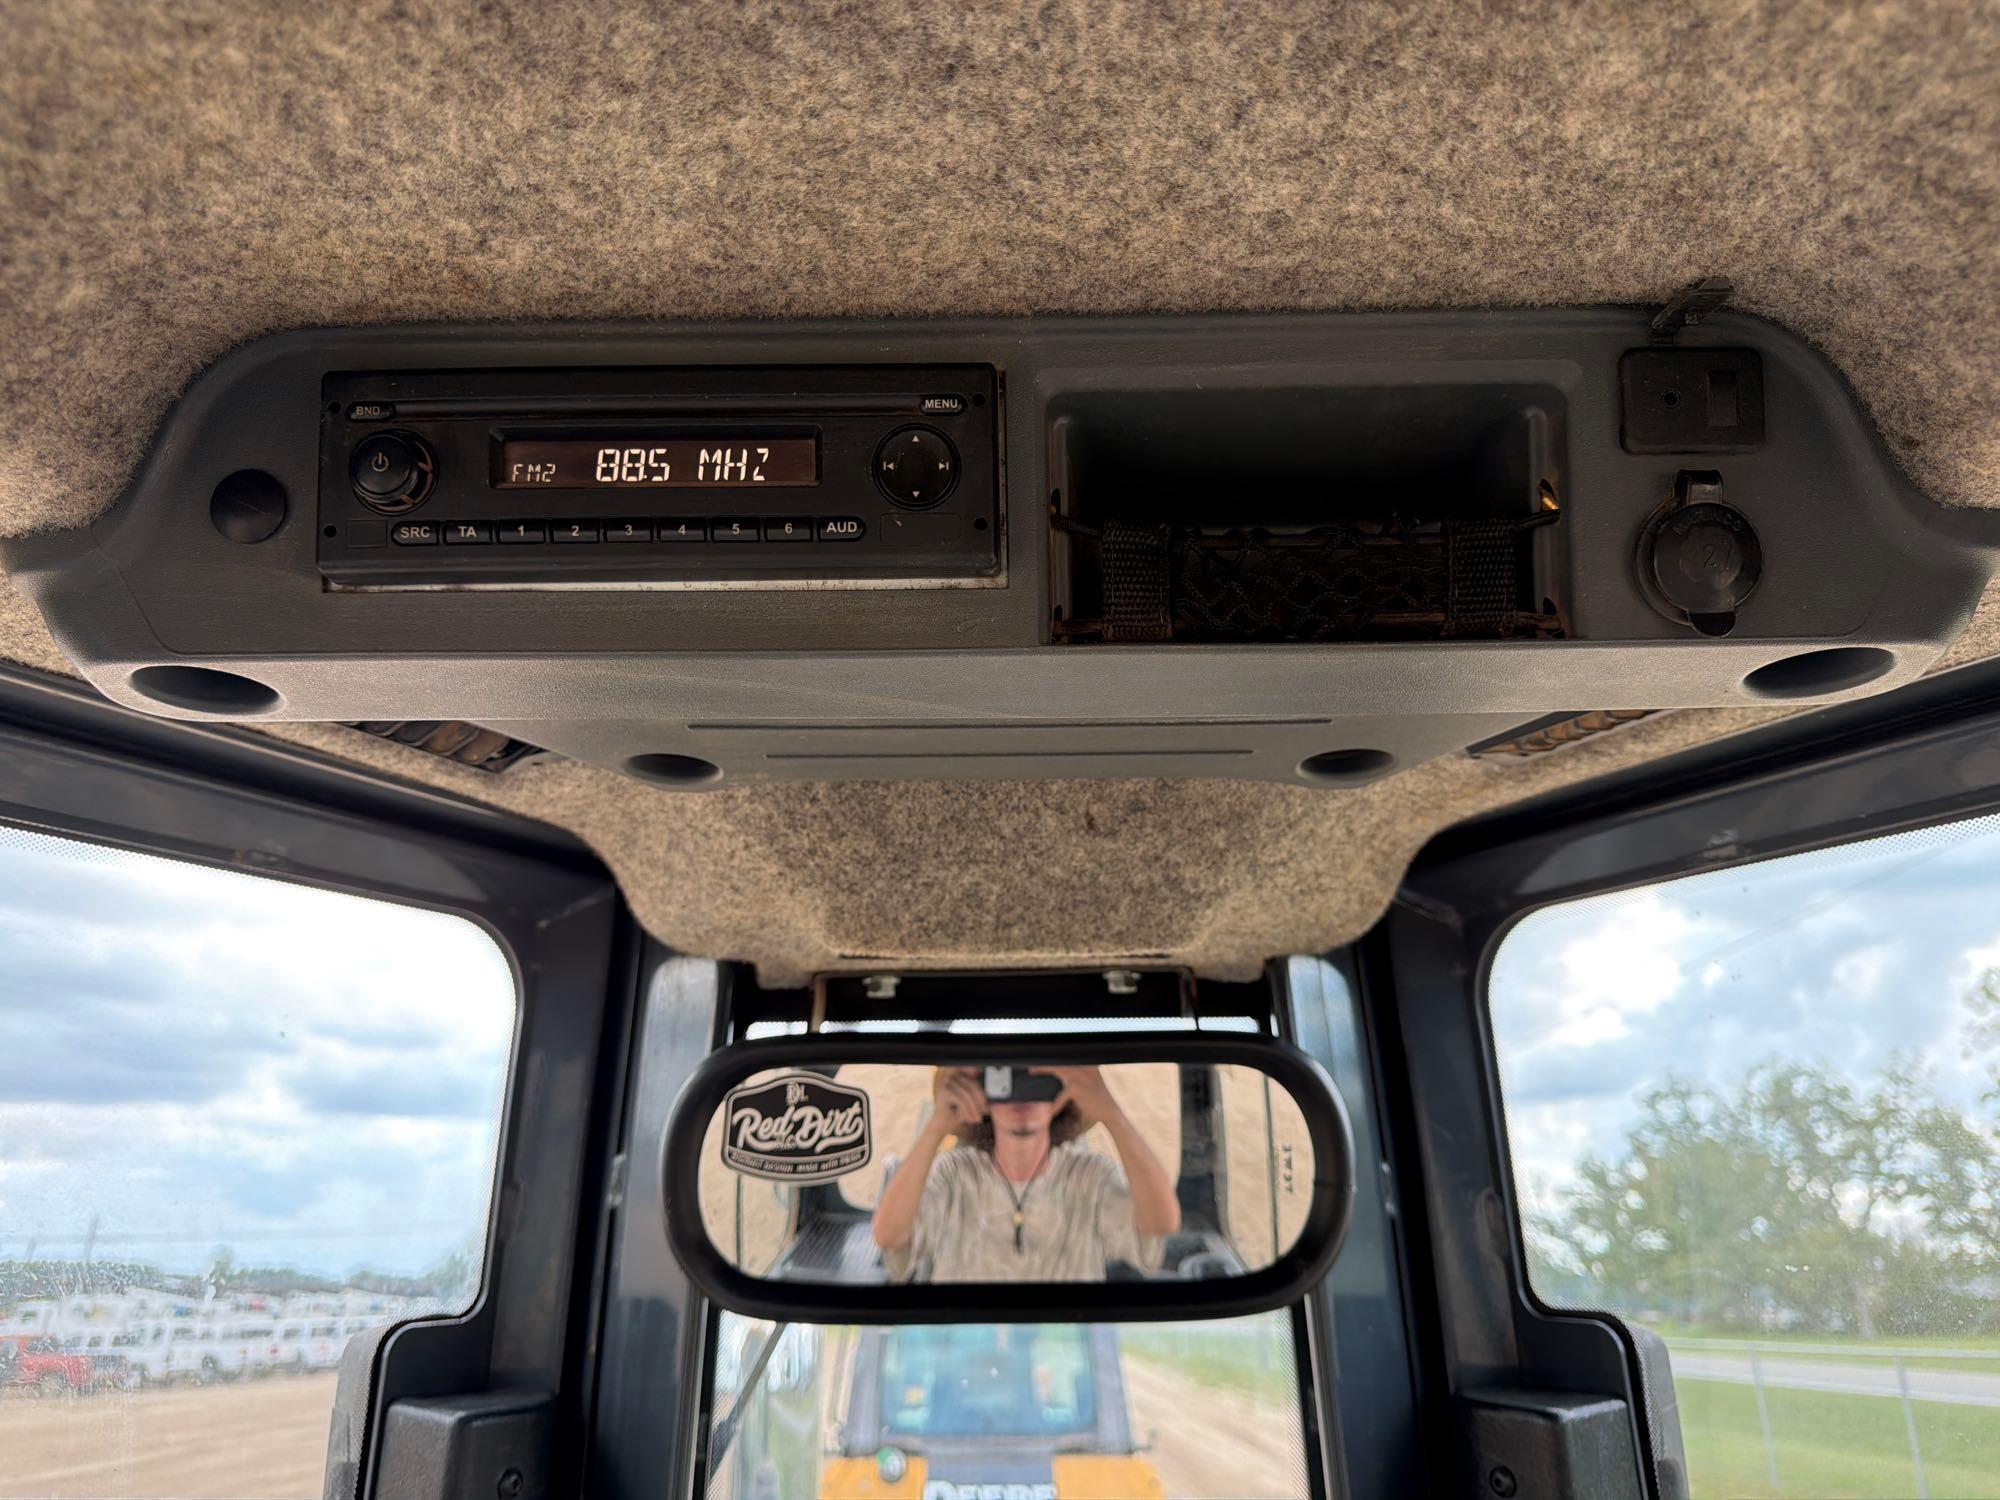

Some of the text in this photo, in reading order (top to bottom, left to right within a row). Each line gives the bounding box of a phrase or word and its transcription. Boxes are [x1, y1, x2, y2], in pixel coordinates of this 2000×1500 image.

[355, 406, 380, 415] BND
[925, 399, 958, 409] MENU
[511, 448, 769, 483] FM2 88.5 MHZ
[400, 522, 858, 538] SRC TA 1 2 3 4 5 6 AUD
[732, 1100, 864, 1154] Red Dirt
